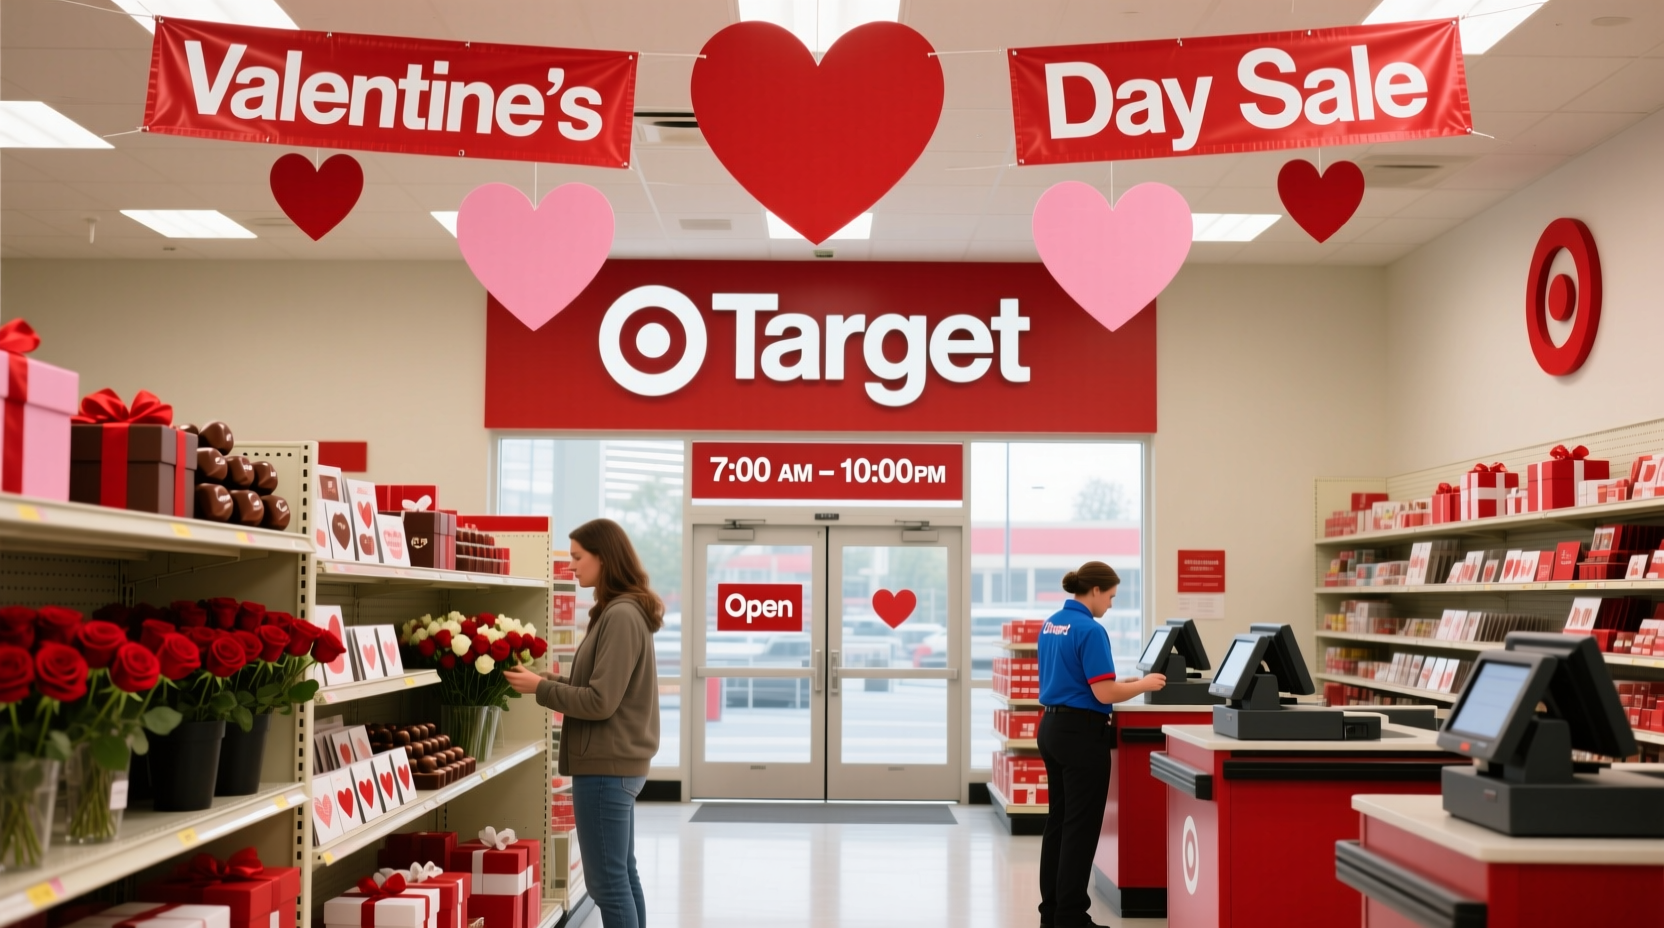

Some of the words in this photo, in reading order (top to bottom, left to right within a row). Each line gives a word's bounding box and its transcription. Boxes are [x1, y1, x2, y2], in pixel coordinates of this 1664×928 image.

[184, 40, 603, 142] Valentine’s
[1045, 61, 1213, 152] Day
[1238, 44, 1429, 130] Sale
[712, 292, 1031, 407] Target
[709, 456, 772, 483] 7:00
[777, 463, 813, 483] AM
[724, 592, 793, 624] Open
